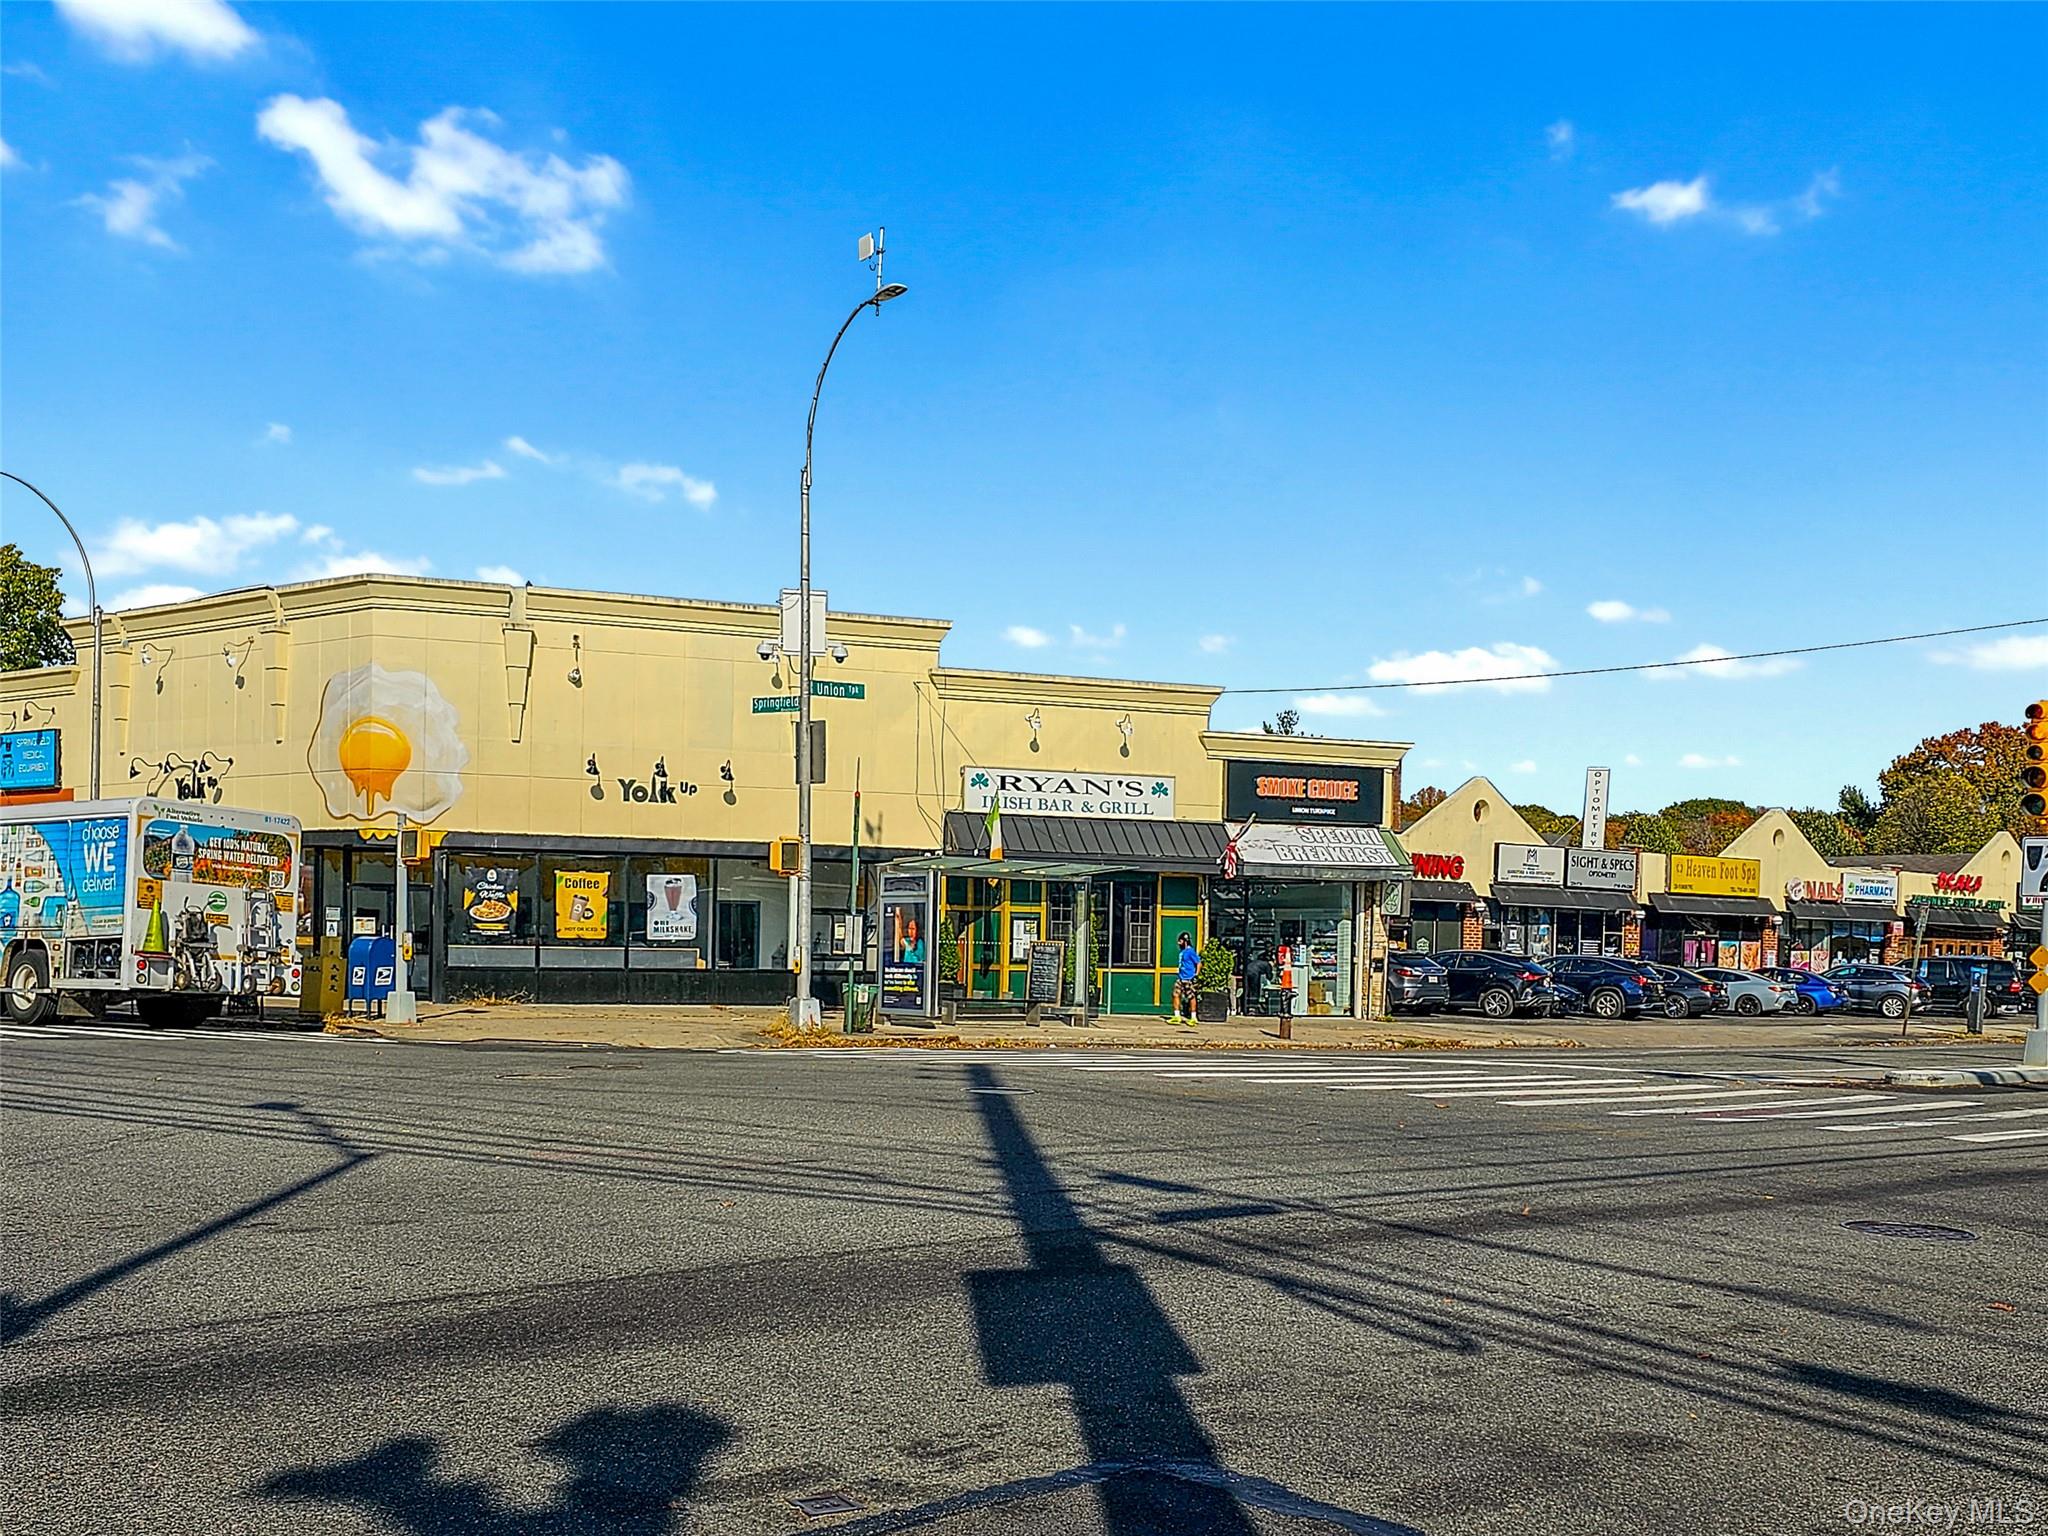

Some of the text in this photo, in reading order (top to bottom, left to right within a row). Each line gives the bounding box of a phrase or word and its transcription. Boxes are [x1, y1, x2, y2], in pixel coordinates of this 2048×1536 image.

[817, 683, 845, 697] Union
[754, 696, 799, 711] Springfield
[617, 773, 698, 804] Yolk Up
[997, 775, 1144, 798] RYAN'S
[1257, 776, 1358, 800] SMOKE CHOICE
[166, 807, 200, 816] Alternative
[1038, 799, 1074, 812] BAR
[1081, 801, 1094, 813] &
[1099, 801, 1154, 816] GRILL
[1591, 771, 1602, 846] OPTOMETRY
[82, 823, 119, 841] choose
[1297, 827, 1384, 846] SPECIAL
[209, 837, 223, 848] GET
[240, 840, 269, 854] NATURAL
[1273, 844, 1394, 864] BREAKFAST
[83, 841, 117, 873] WE
[198, 848, 279, 867] SPRING WATER DELIVERED
[1571, 855, 1635, 871] SIGHT & SPECS
[1686, 858, 1757, 885] Heaven Foot Spa
[82, 873, 117, 893] deliver!
[564, 877, 600, 889] Coffee
[1804, 881, 1843, 900] NAILS
[1855, 885, 1894, 897] PHARMACY
[328, 923, 335, 933] A
